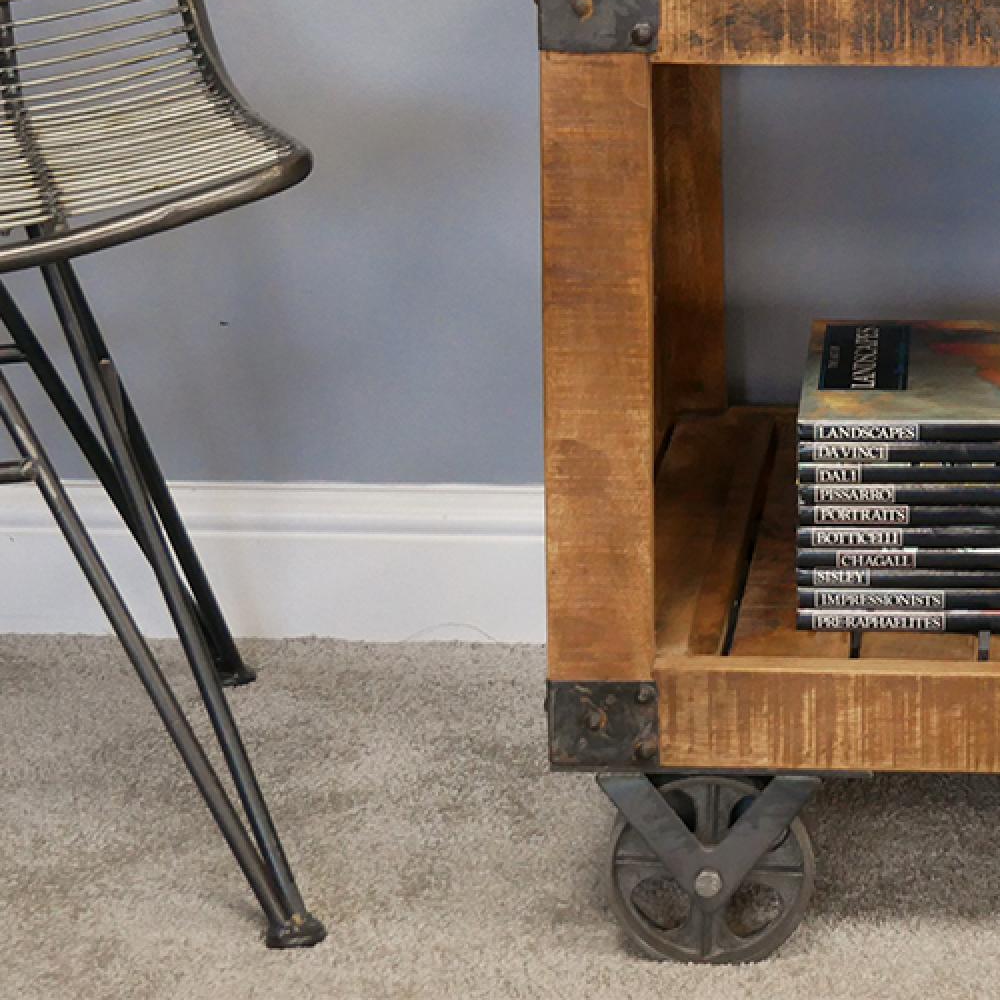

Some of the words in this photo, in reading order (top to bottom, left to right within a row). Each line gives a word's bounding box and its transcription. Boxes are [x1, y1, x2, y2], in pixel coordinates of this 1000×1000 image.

[819, 425, 916, 439] LANDSCAPES
[819, 469, 858, 481] DALI
[820, 487, 894, 501] PISSARRO
[820, 509, 907, 521] PORTRAITS
[840, 554, 911, 567] CHAGALL
[820, 593, 942, 607] IMPRESSIONISTS
